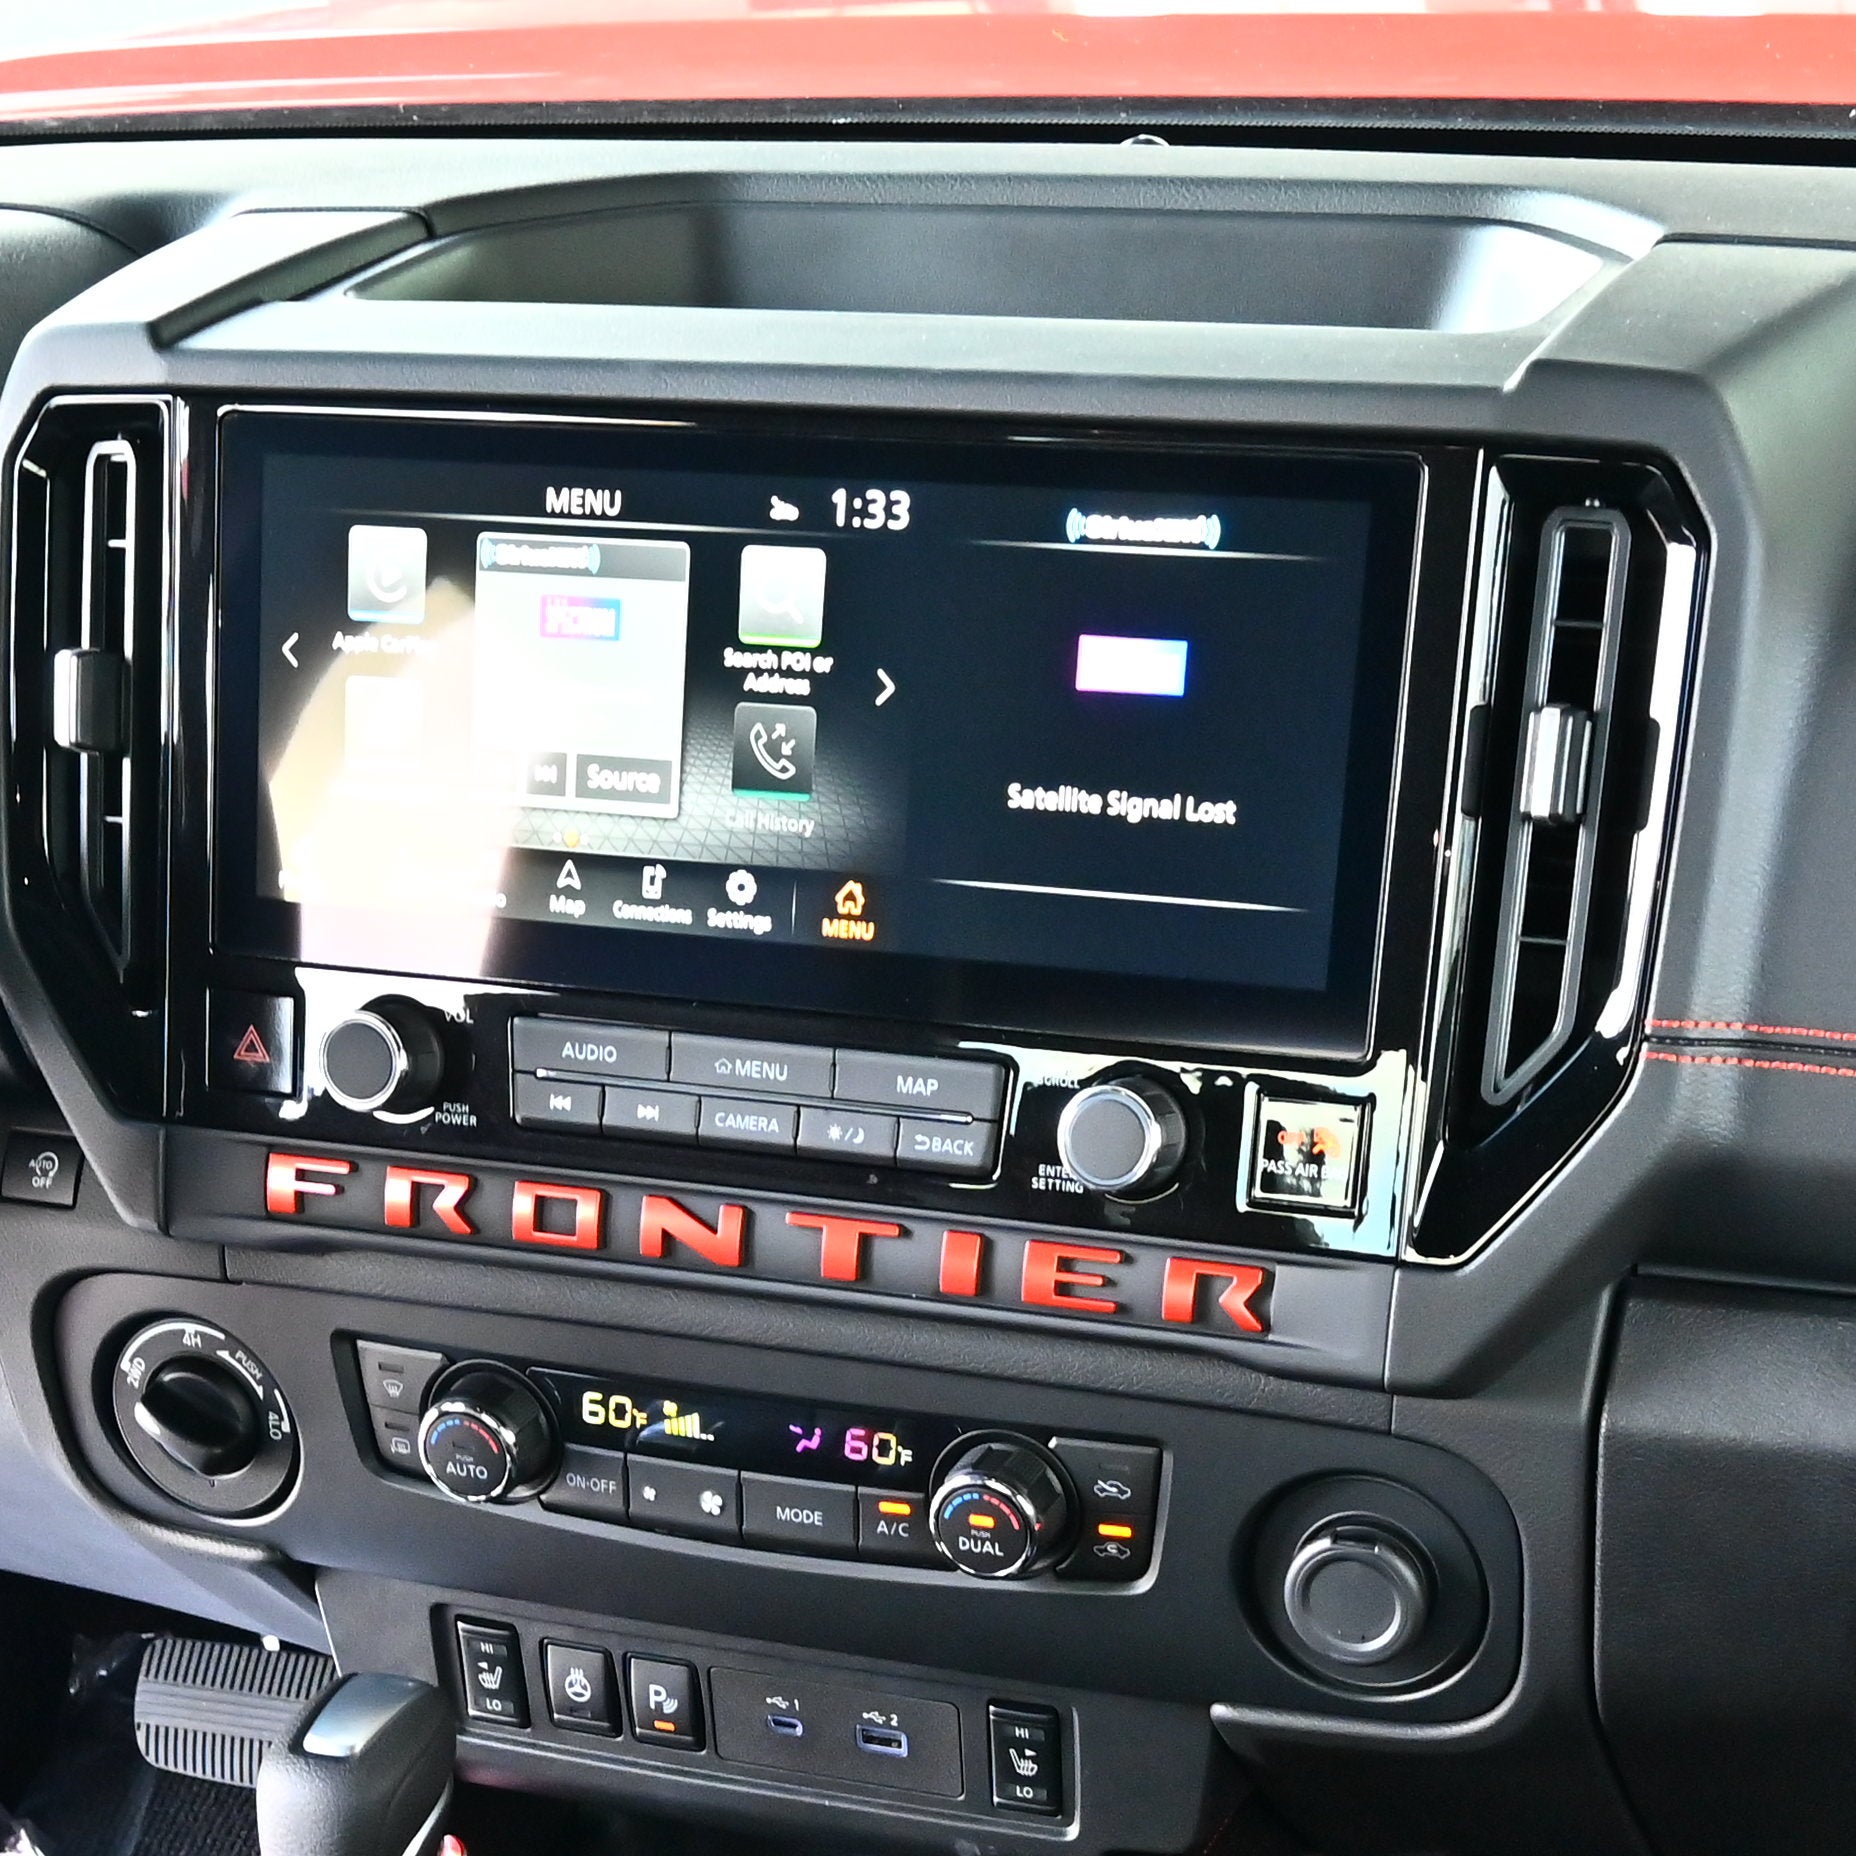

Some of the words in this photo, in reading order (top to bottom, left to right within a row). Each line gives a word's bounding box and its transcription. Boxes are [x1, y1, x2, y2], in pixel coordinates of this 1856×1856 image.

[546, 486, 622, 517] MENU
[832, 488, 911, 530] 1:33
[724, 647, 778, 671] Search
[813, 655, 834, 674] or
[744, 672, 811, 697] Address
[587, 764, 661, 794] Source
[1007, 783, 1102, 815] Satellite
[1107, 790, 1181, 824] Signal
[1185, 796, 1237, 825] Lost
[760, 814, 815, 838] History
[549, 894, 586, 918] Map
[612, 900, 693, 926] Connections
[707, 908, 772, 935] Settings
[821, 918, 875, 942] MENU
[444, 1008, 474, 1024] VOL
[562, 1041, 617, 1063] AUDIO
[734, 1060, 789, 1082] MENU
[896, 1075, 939, 1097] MAP
[443, 1101, 470, 1113] PUSH
[435, 1113, 477, 1127] POWER
[714, 1112, 780, 1133] CAMERA
[931, 1136, 974, 1157] BACK
[1261, 1158, 1293, 1176] PASS
[1295, 1163, 1319, 1179] AIR
[31, 1176, 53, 1189] OFF
[1031, 1176, 1084, 1195] SETTING
[265, 1152, 1274, 1336] FRONTIER
[181, 1332, 203, 1349] 4H
[126, 1356, 146, 1389] 2WD
[234, 1349, 263, 1381] PUSH
[267, 1411, 283, 1441] 4LO
[446, 1461, 489, 1481] AUTO
[775, 1505, 824, 1527] MODE
[876, 1520, 911, 1539] A/C
[957, 1535, 1005, 1558] DUAL
[479, 1641, 495, 1654] HI
[485, 1697, 502, 1712] LO
[1014, 1726, 1030, 1739] HI
[1015, 1785, 1034, 1800] LO
